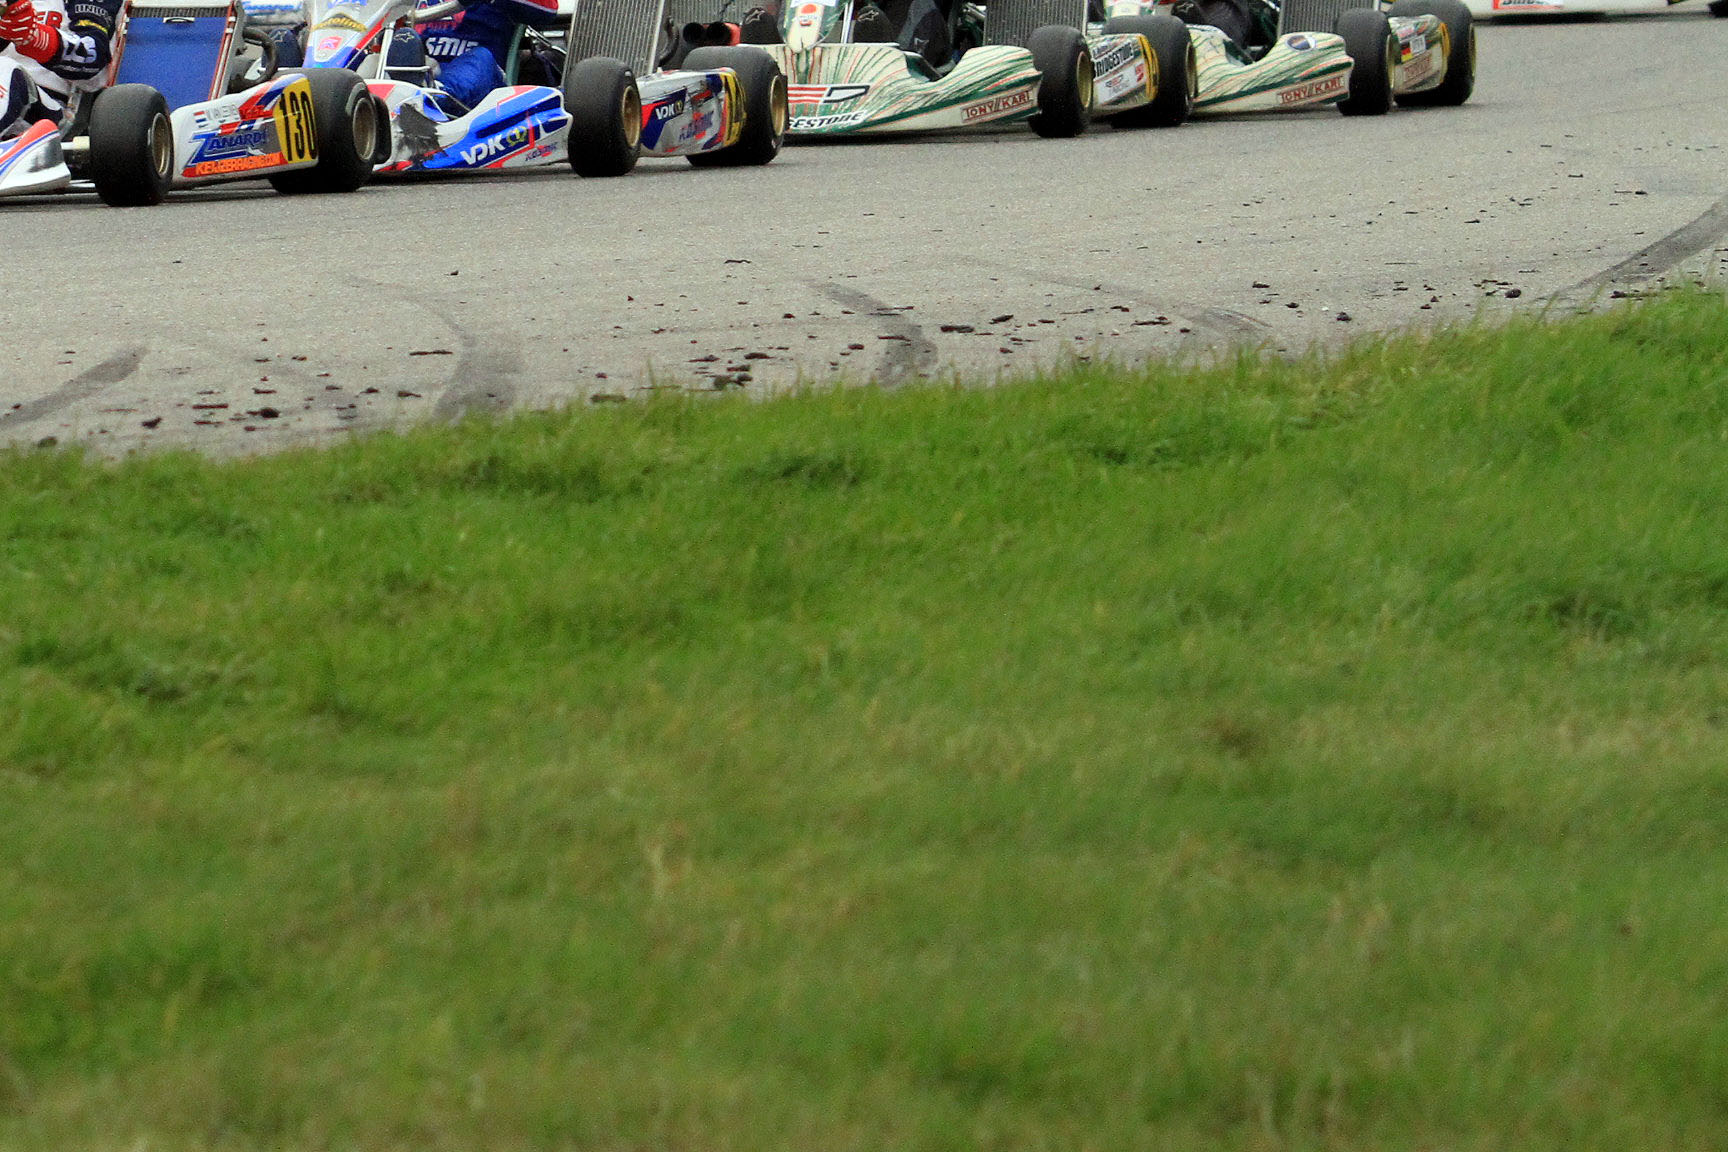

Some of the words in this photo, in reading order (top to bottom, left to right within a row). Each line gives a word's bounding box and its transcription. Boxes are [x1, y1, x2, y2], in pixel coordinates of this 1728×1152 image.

[655, 103, 674, 121] VDK
[964, 104, 996, 118] TONY
[1001, 92, 1033, 112] KART
[281, 90, 318, 162] 130
[460, 133, 505, 165] VDK
